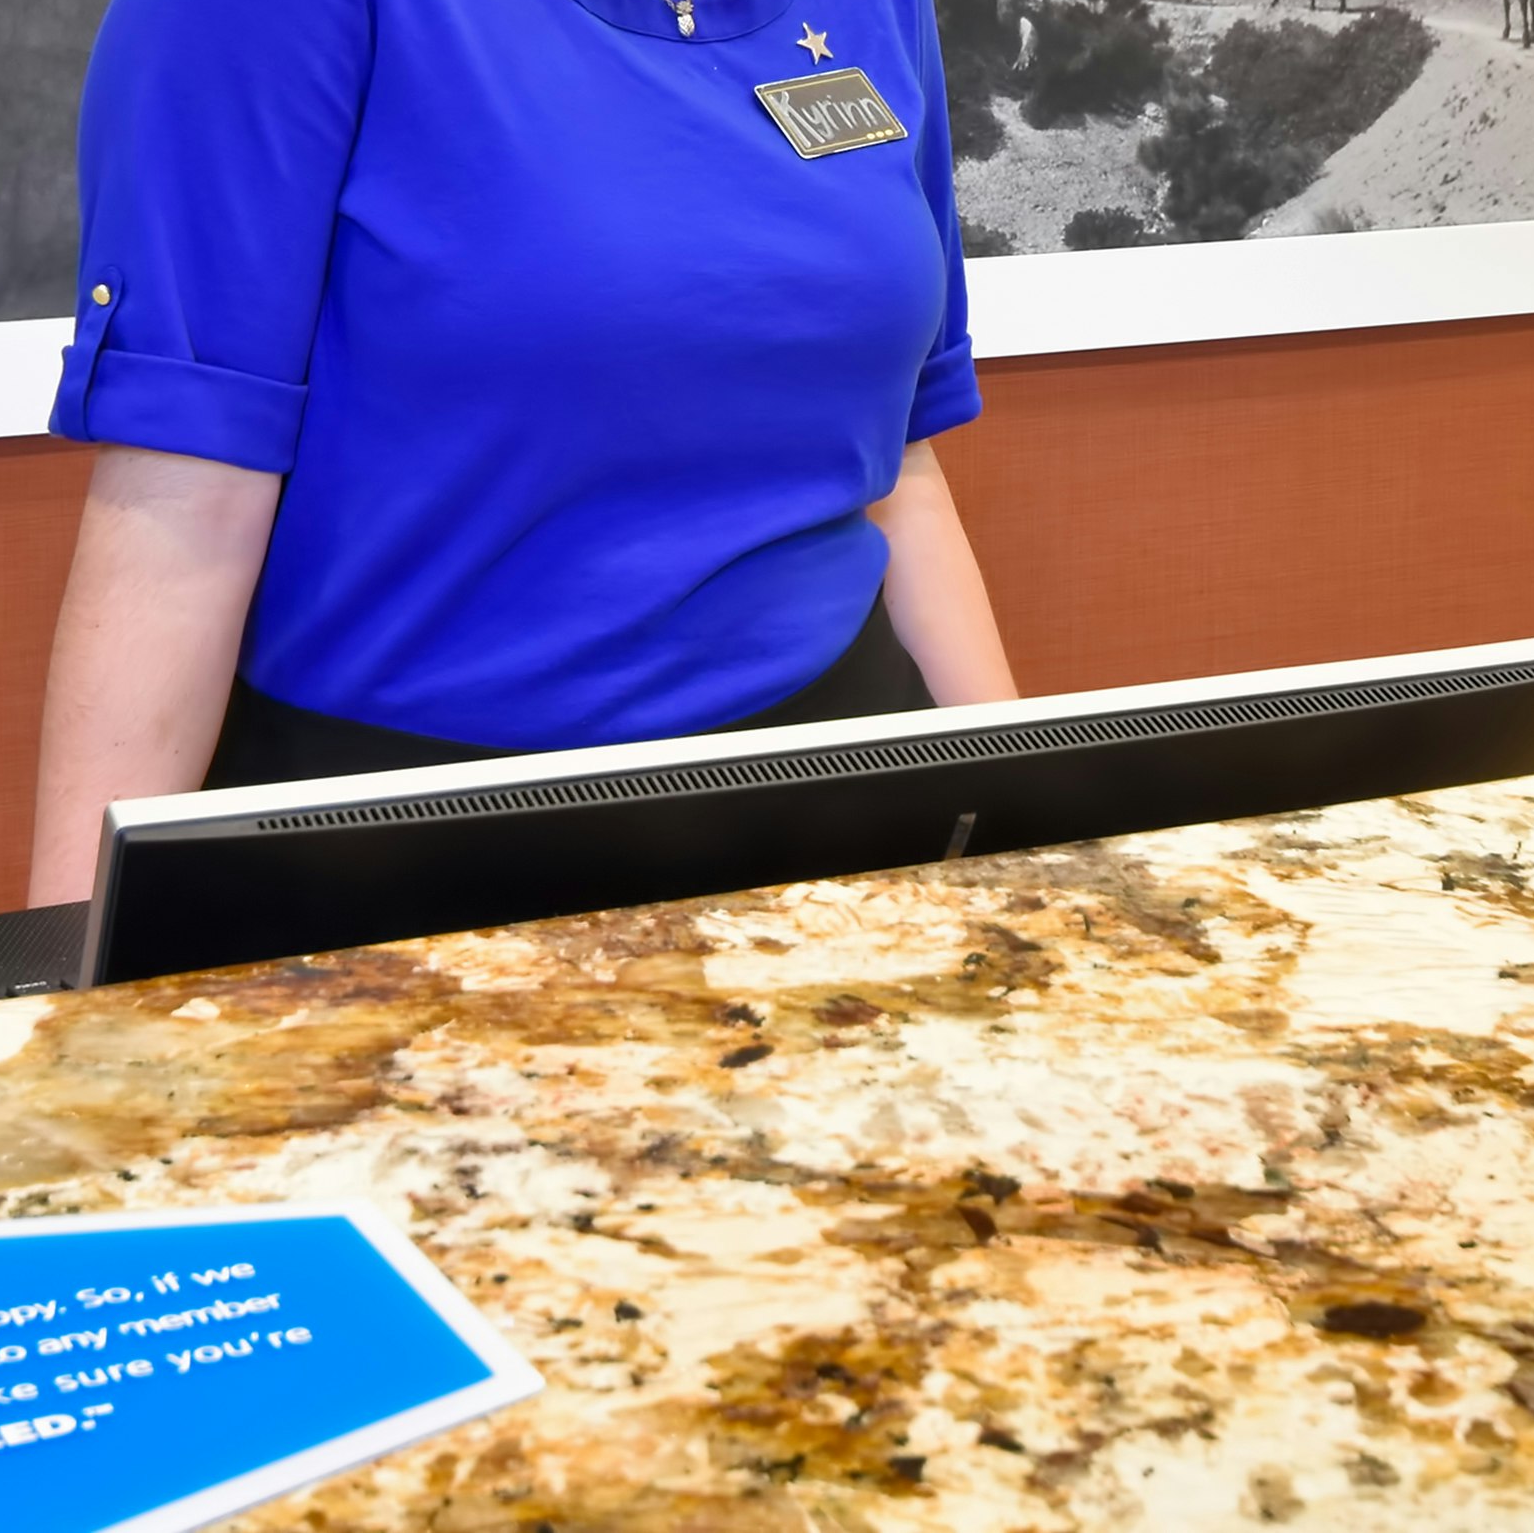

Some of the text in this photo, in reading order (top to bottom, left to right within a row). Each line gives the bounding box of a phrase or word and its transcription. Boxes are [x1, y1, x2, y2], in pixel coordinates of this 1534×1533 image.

[76, 1287, 145, 1309] So,
[151, 1271, 180, 1294] if
[191, 1263, 256, 1286] we
[38, 1327, 108, 1355] any
[118, 1293, 280, 1336] member
[54, 1359, 154, 1392] sure
[166, 1327, 312, 1373] you're
